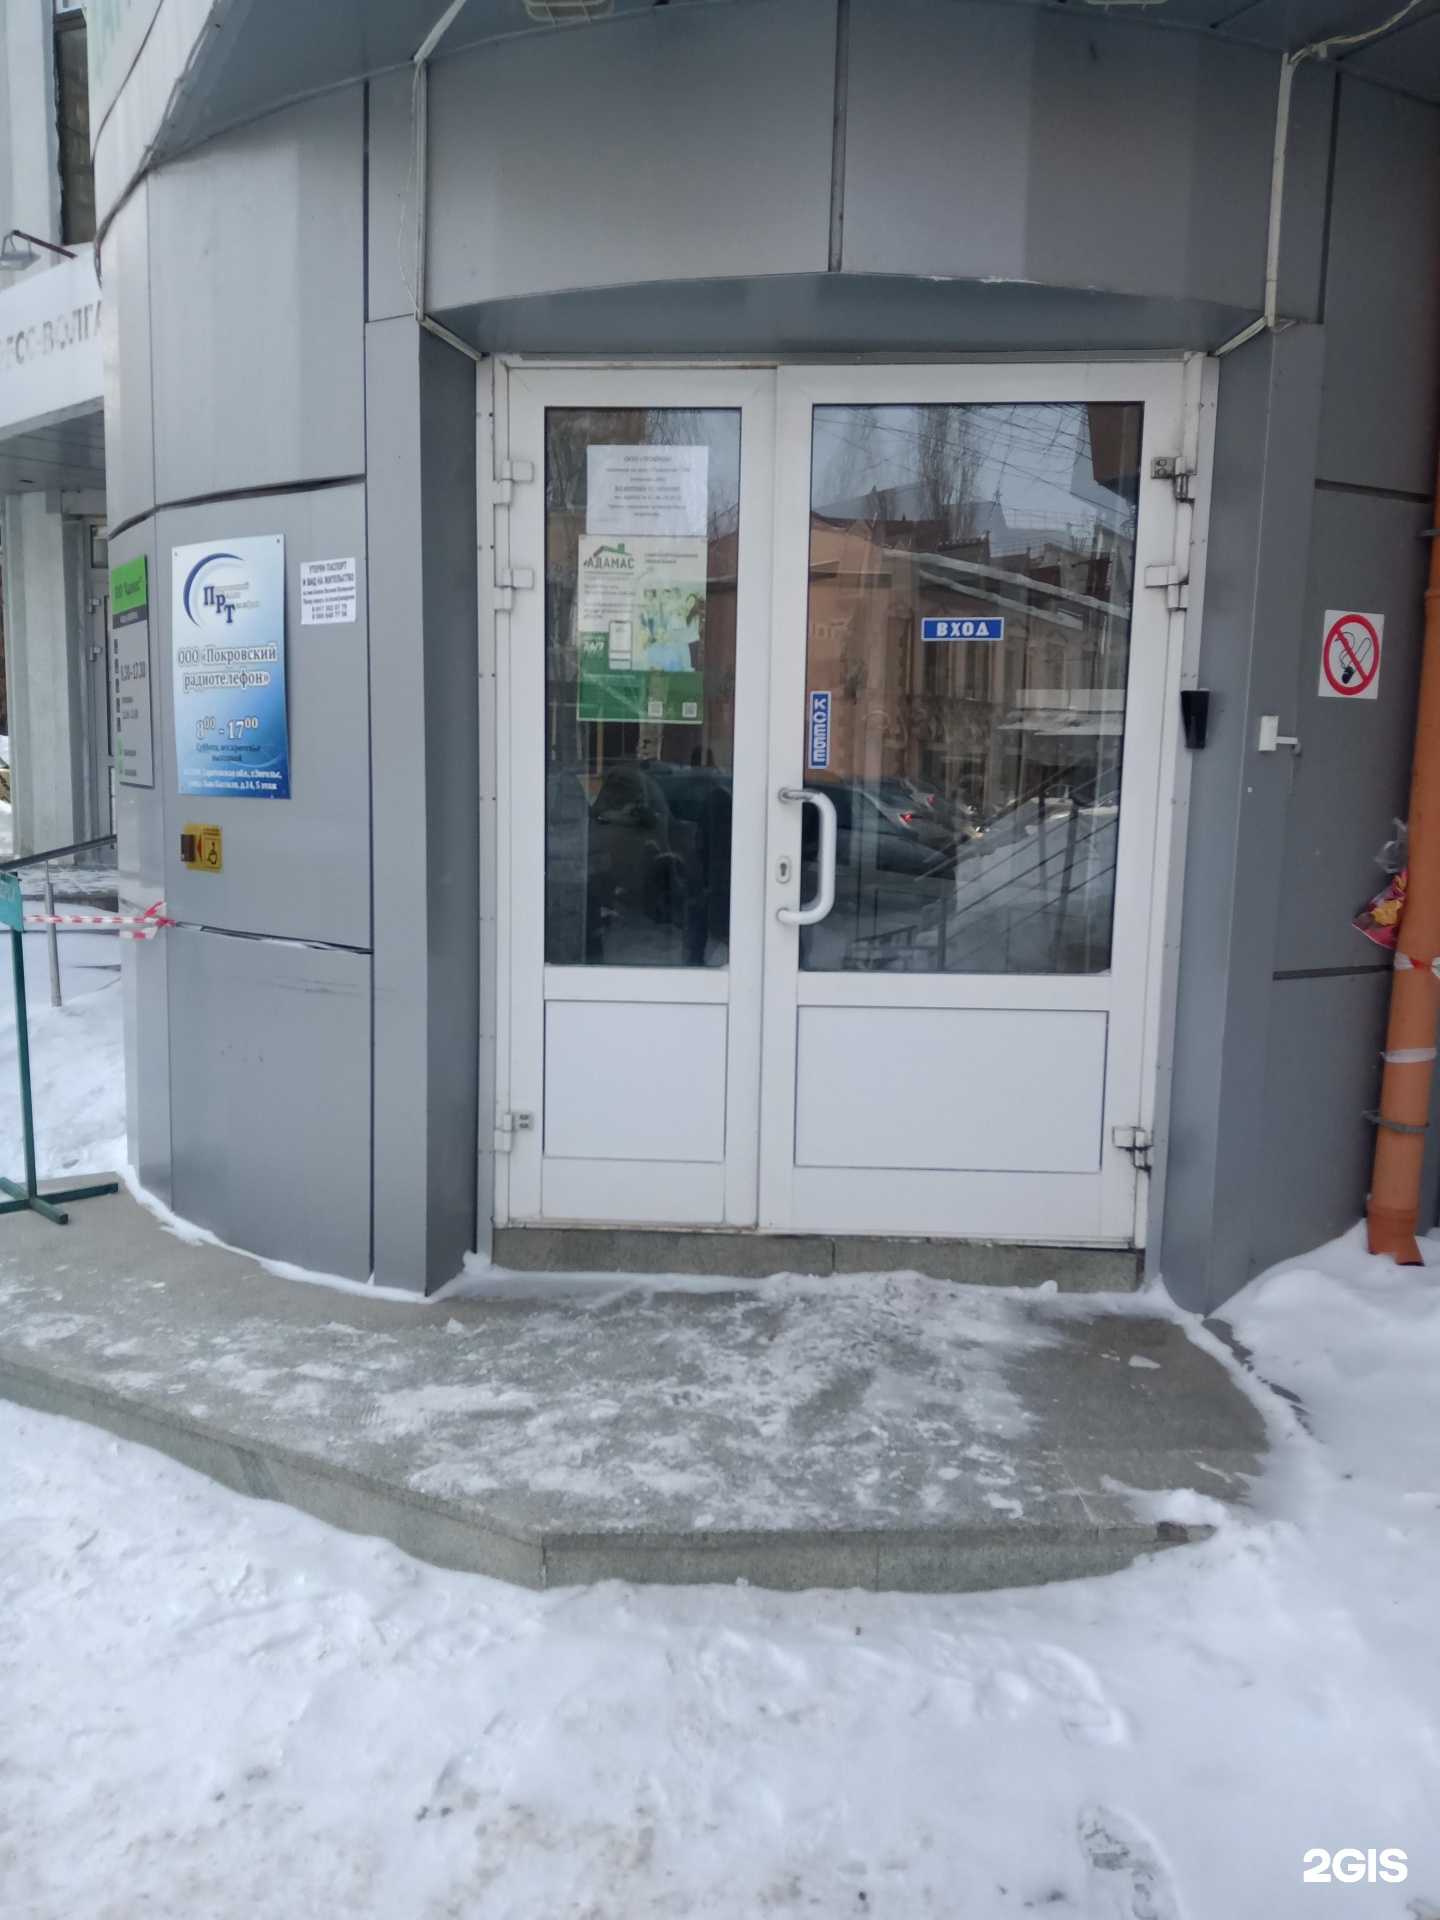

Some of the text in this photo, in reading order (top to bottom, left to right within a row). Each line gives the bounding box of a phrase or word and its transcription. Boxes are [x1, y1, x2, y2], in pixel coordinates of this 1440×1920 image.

[586, 556, 636, 569] АДАМАС
[936, 621, 990, 637] ВХОД
[178, 648, 200, 664] ООО
